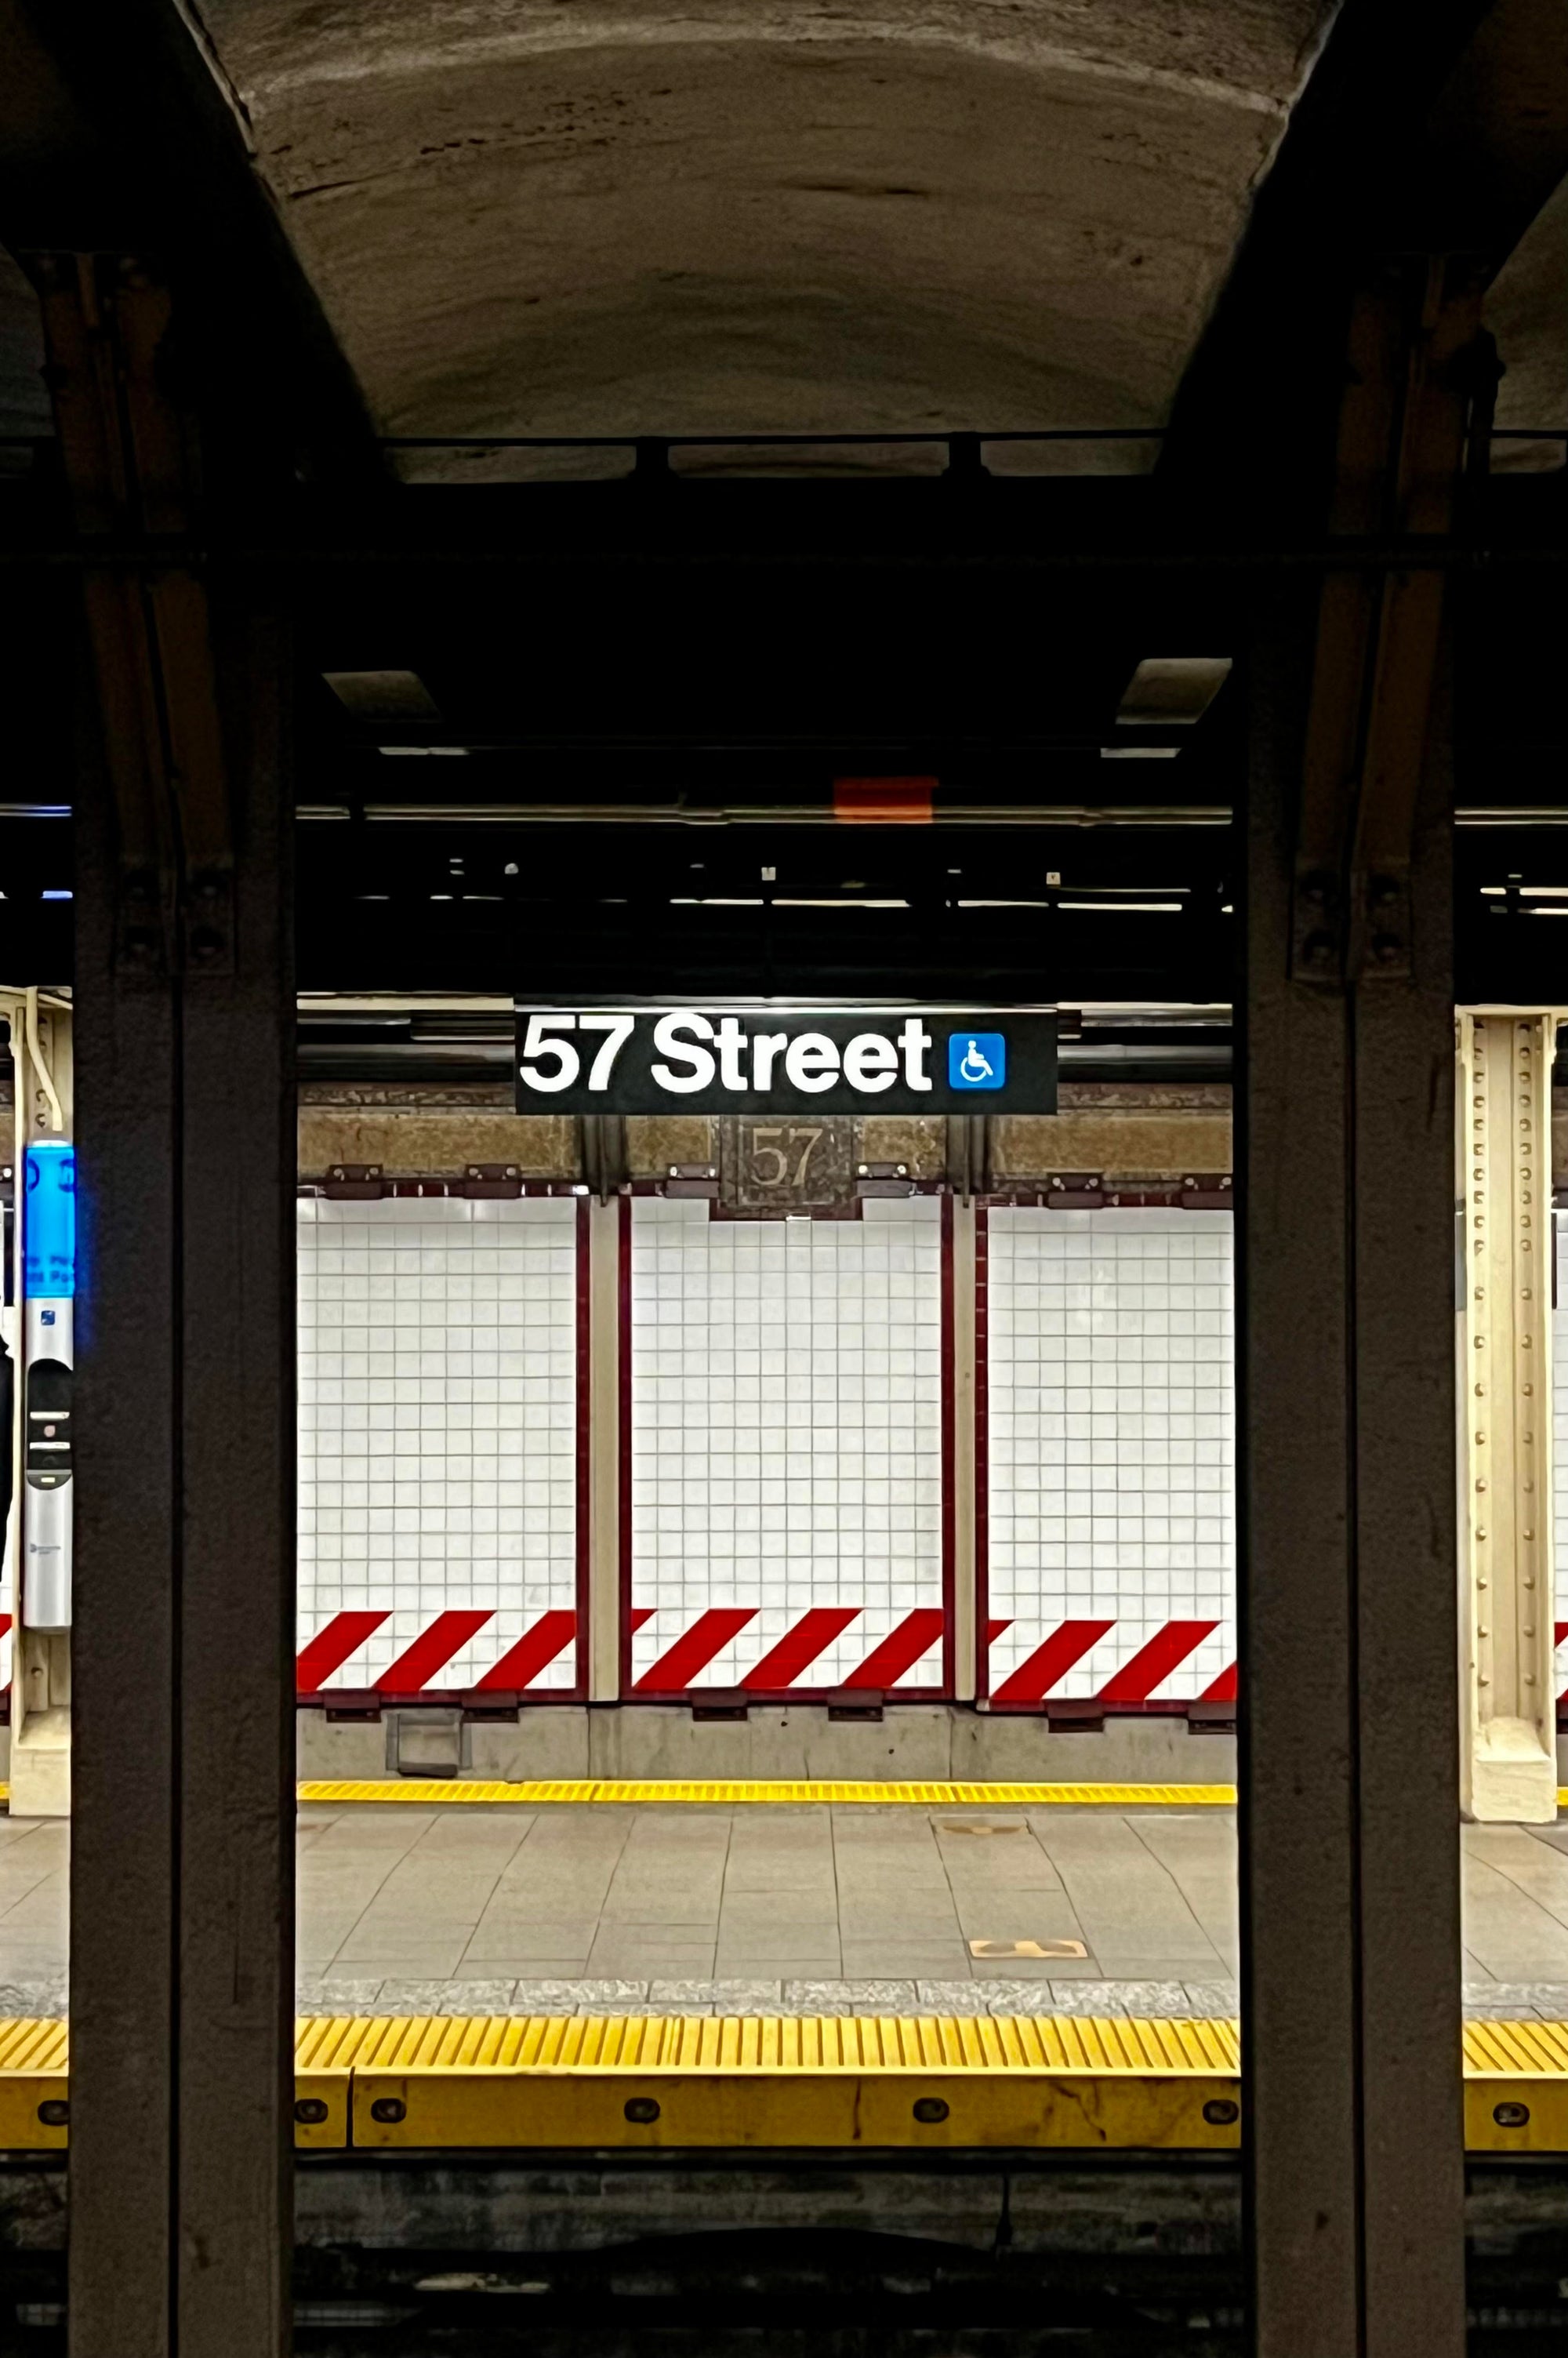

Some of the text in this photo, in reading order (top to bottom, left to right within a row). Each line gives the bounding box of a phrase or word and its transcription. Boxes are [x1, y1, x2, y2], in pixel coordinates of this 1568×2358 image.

[519, 1012, 933, 1093] 57 Street
[751, 1128, 823, 1186] 57
